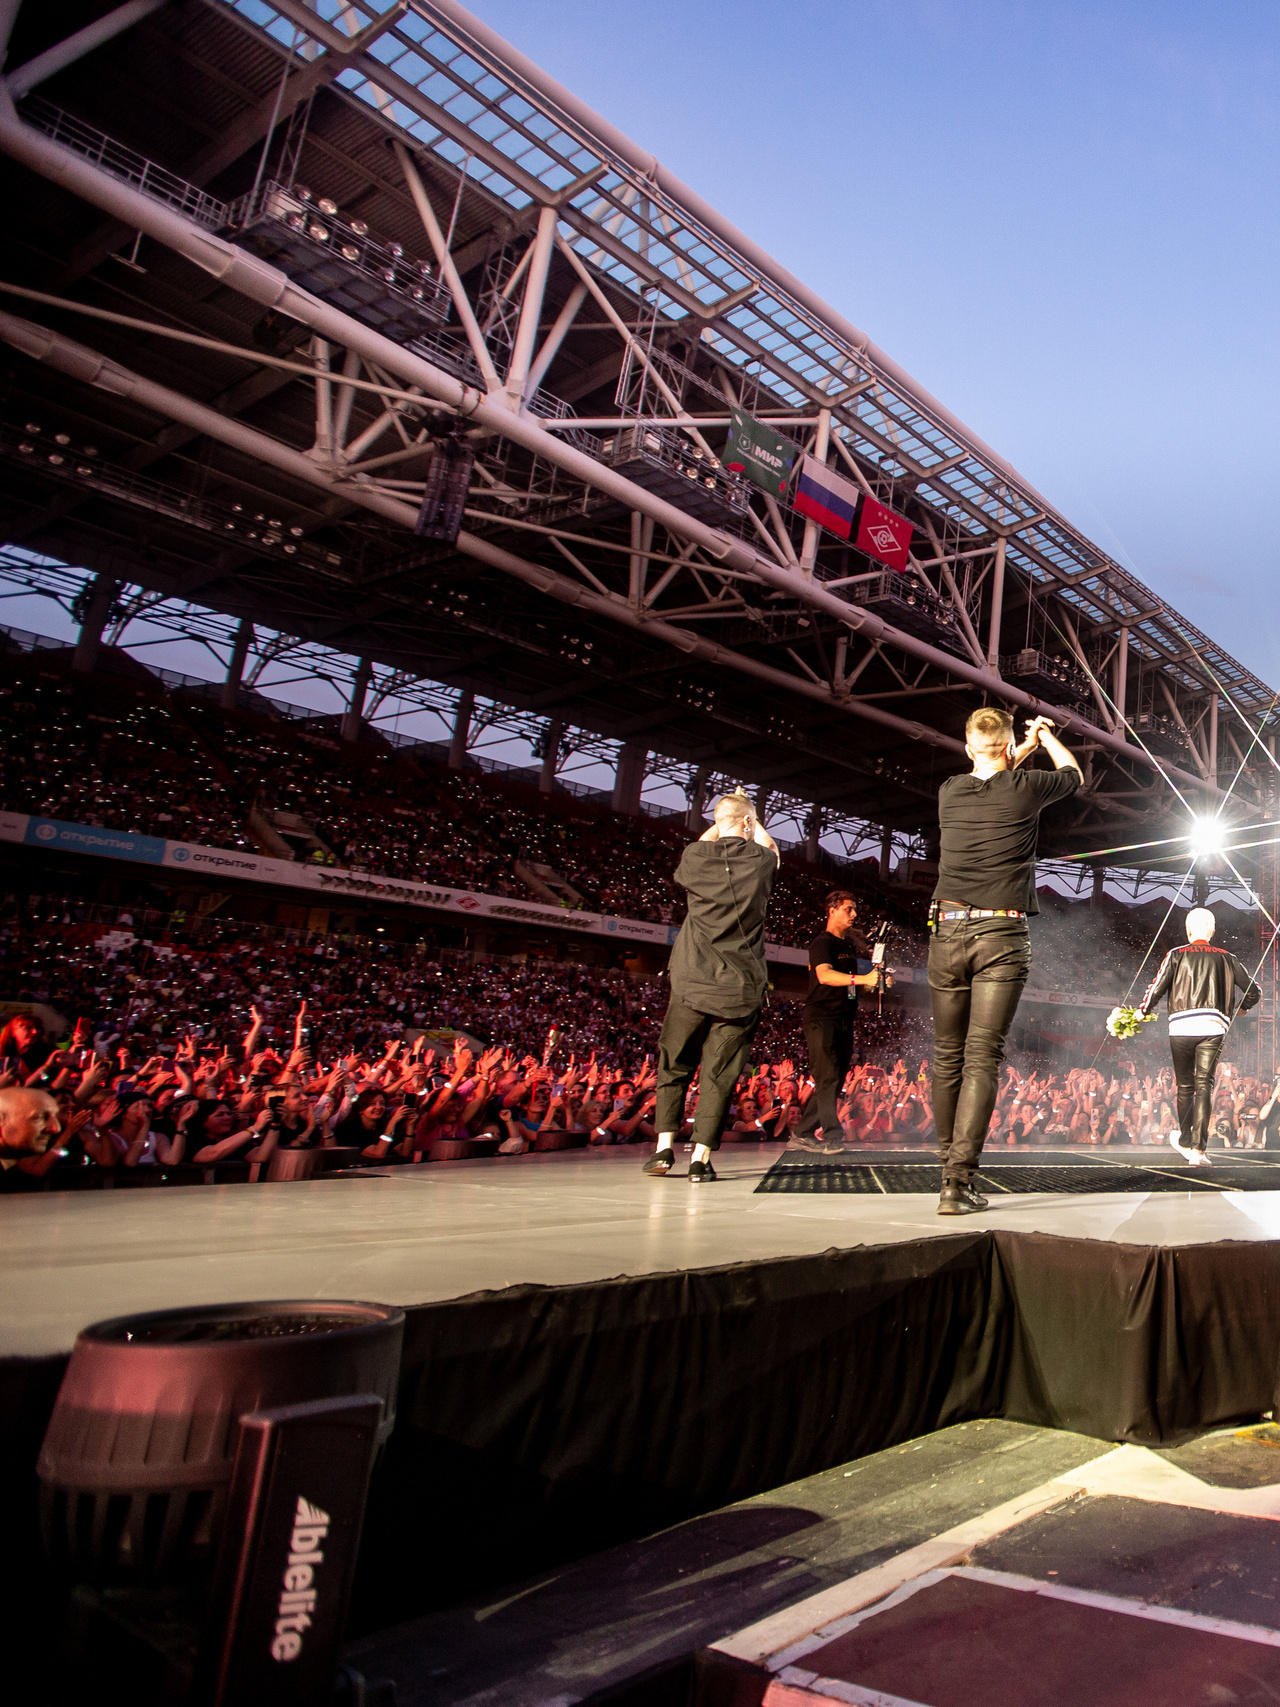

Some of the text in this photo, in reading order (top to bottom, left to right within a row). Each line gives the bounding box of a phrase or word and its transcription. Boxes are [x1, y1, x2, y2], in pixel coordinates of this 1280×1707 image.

[754, 445, 783, 468] МИР
[60, 831, 134, 850] открытие
[193, 853, 257, 870] открытие
[619, 924, 654, 935] открытие
[1179, 945, 1228, 954] HOLLYWOOD
[270, 1495, 331, 1662] Ablelite
